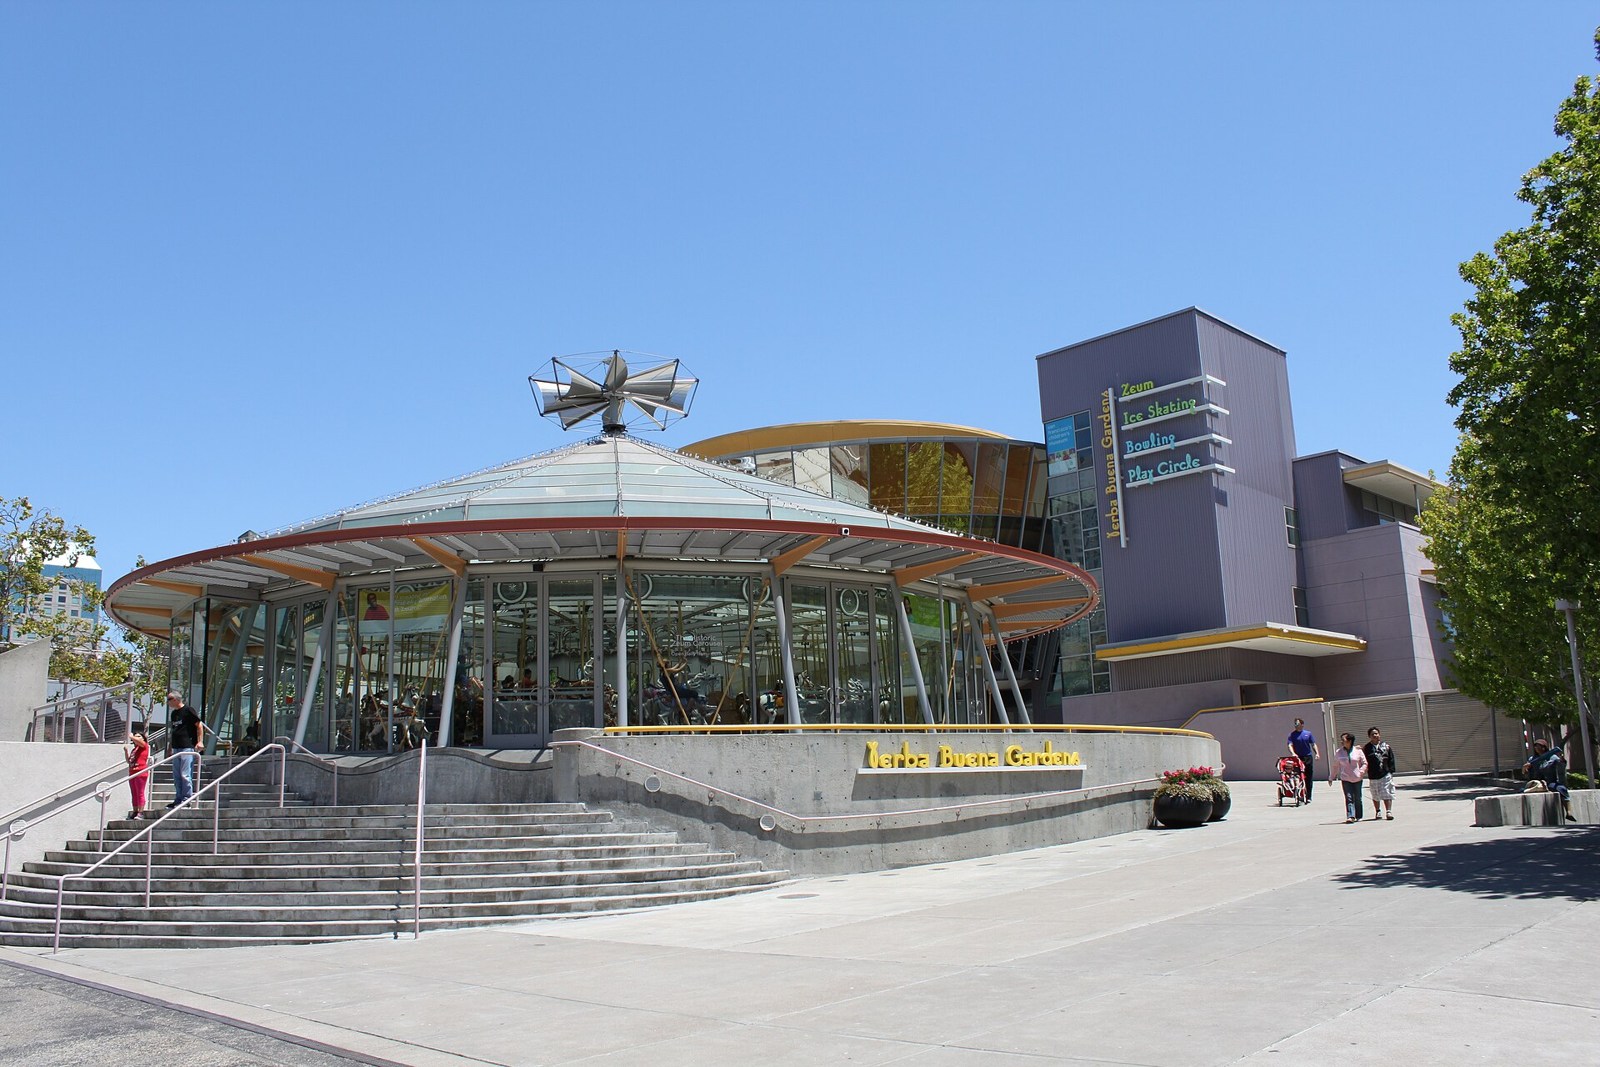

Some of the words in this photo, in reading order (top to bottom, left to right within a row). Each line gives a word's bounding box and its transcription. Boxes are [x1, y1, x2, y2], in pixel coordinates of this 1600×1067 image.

[1121, 381, 1154, 396] Zeum
[1098, 390, 1113, 448] Gardens
[1123, 412, 1143, 424] Ice
[1148, 398, 1196, 416] Skating
[1126, 432, 1176, 453] Bowling
[1106, 454, 1116, 494] Buena
[1128, 466, 1154, 485] Play
[1157, 454, 1200, 475] Circle
[1105, 500, 1120, 538] Yerba
[866, 740, 929, 768] Yerba
[939, 744, 999, 768] Buena
[1005, 740, 1081, 766] Gardens
